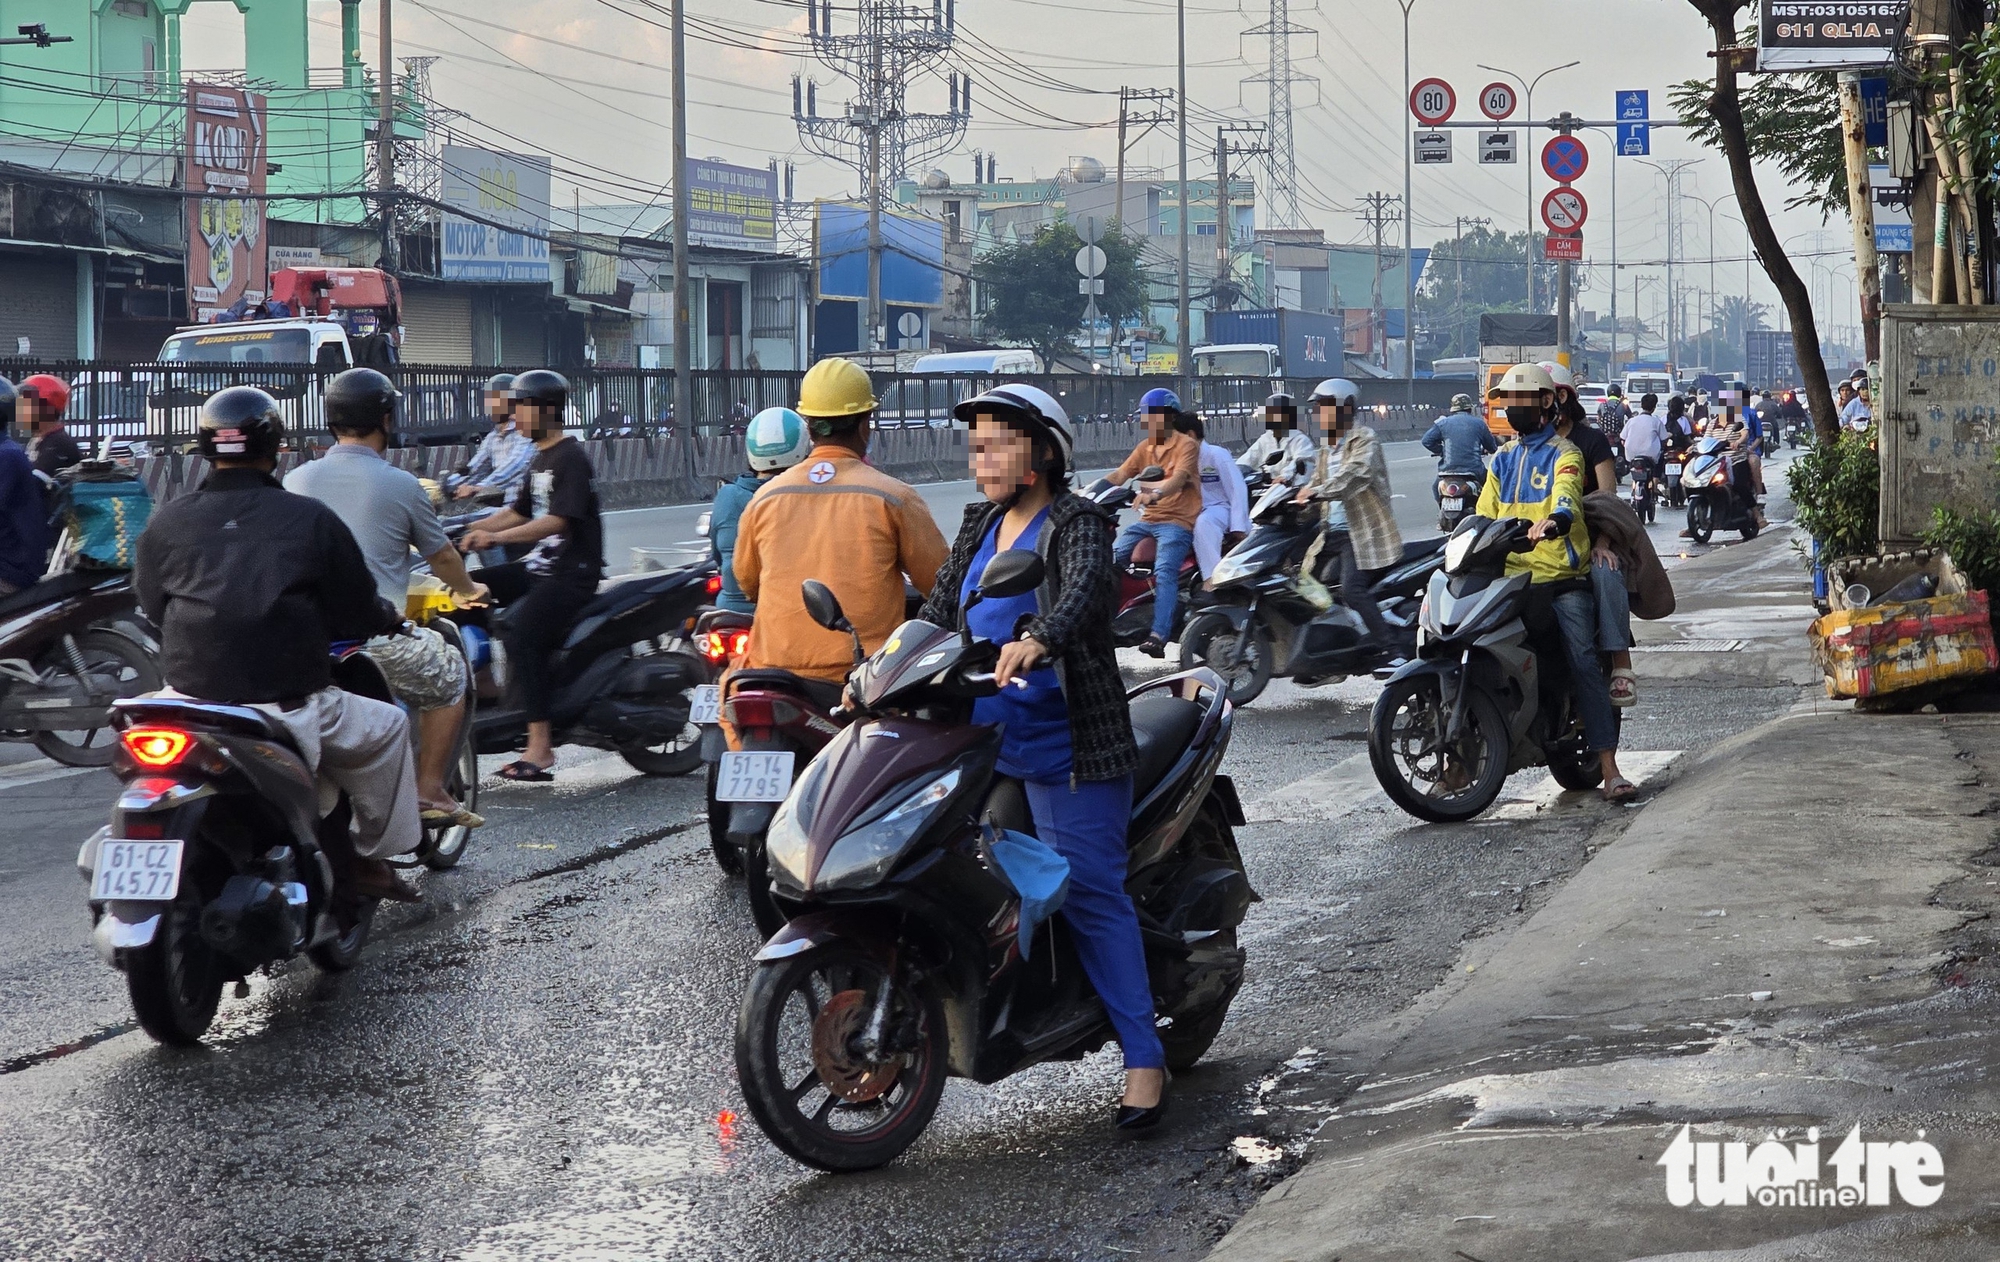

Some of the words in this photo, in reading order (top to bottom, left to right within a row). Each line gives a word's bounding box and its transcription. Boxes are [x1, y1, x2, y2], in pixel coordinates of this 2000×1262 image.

[1777, 23, 1814, 37] 611
[1822, 23, 1881, 39] QL1A
[1423, 92, 1443, 112] 80
[1490, 93, 1506, 109] 60
[195, 121, 249, 172] KOBE
[445, 222, 485, 256] MOTOR
[1556, 240, 1571, 250] CẤM
[195, 331, 275, 345] BRIDGESTONE
[732, 755, 782, 775] 51-Y4
[728, 777, 781, 797] 7795
[110, 844, 169, 869] 61-C2
[103, 870, 174, 896] 145.77
